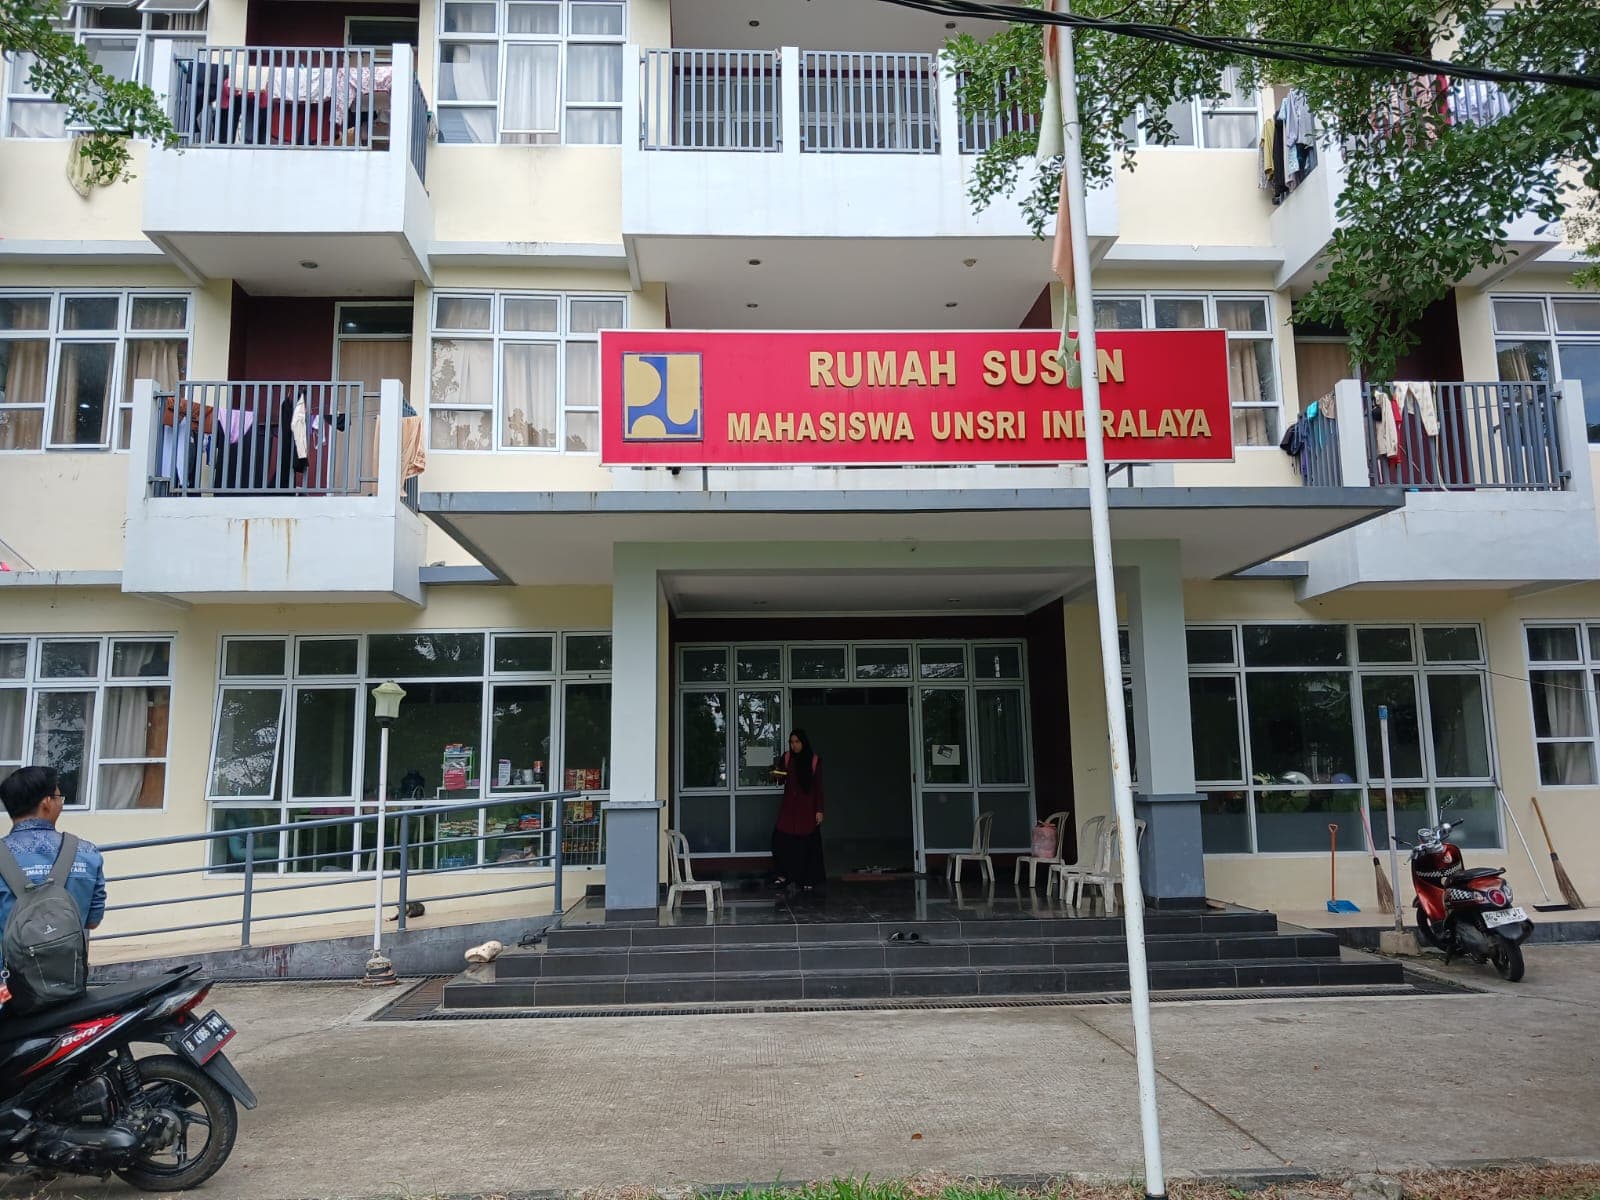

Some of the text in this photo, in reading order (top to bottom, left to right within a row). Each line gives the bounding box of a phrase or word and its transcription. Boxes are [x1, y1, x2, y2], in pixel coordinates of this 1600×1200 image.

[810, 348, 1125, 387] RUMAH SUSN
[727, 411, 915, 442] MAHASISWA
[931, 410, 1027, 441] UNSRI
